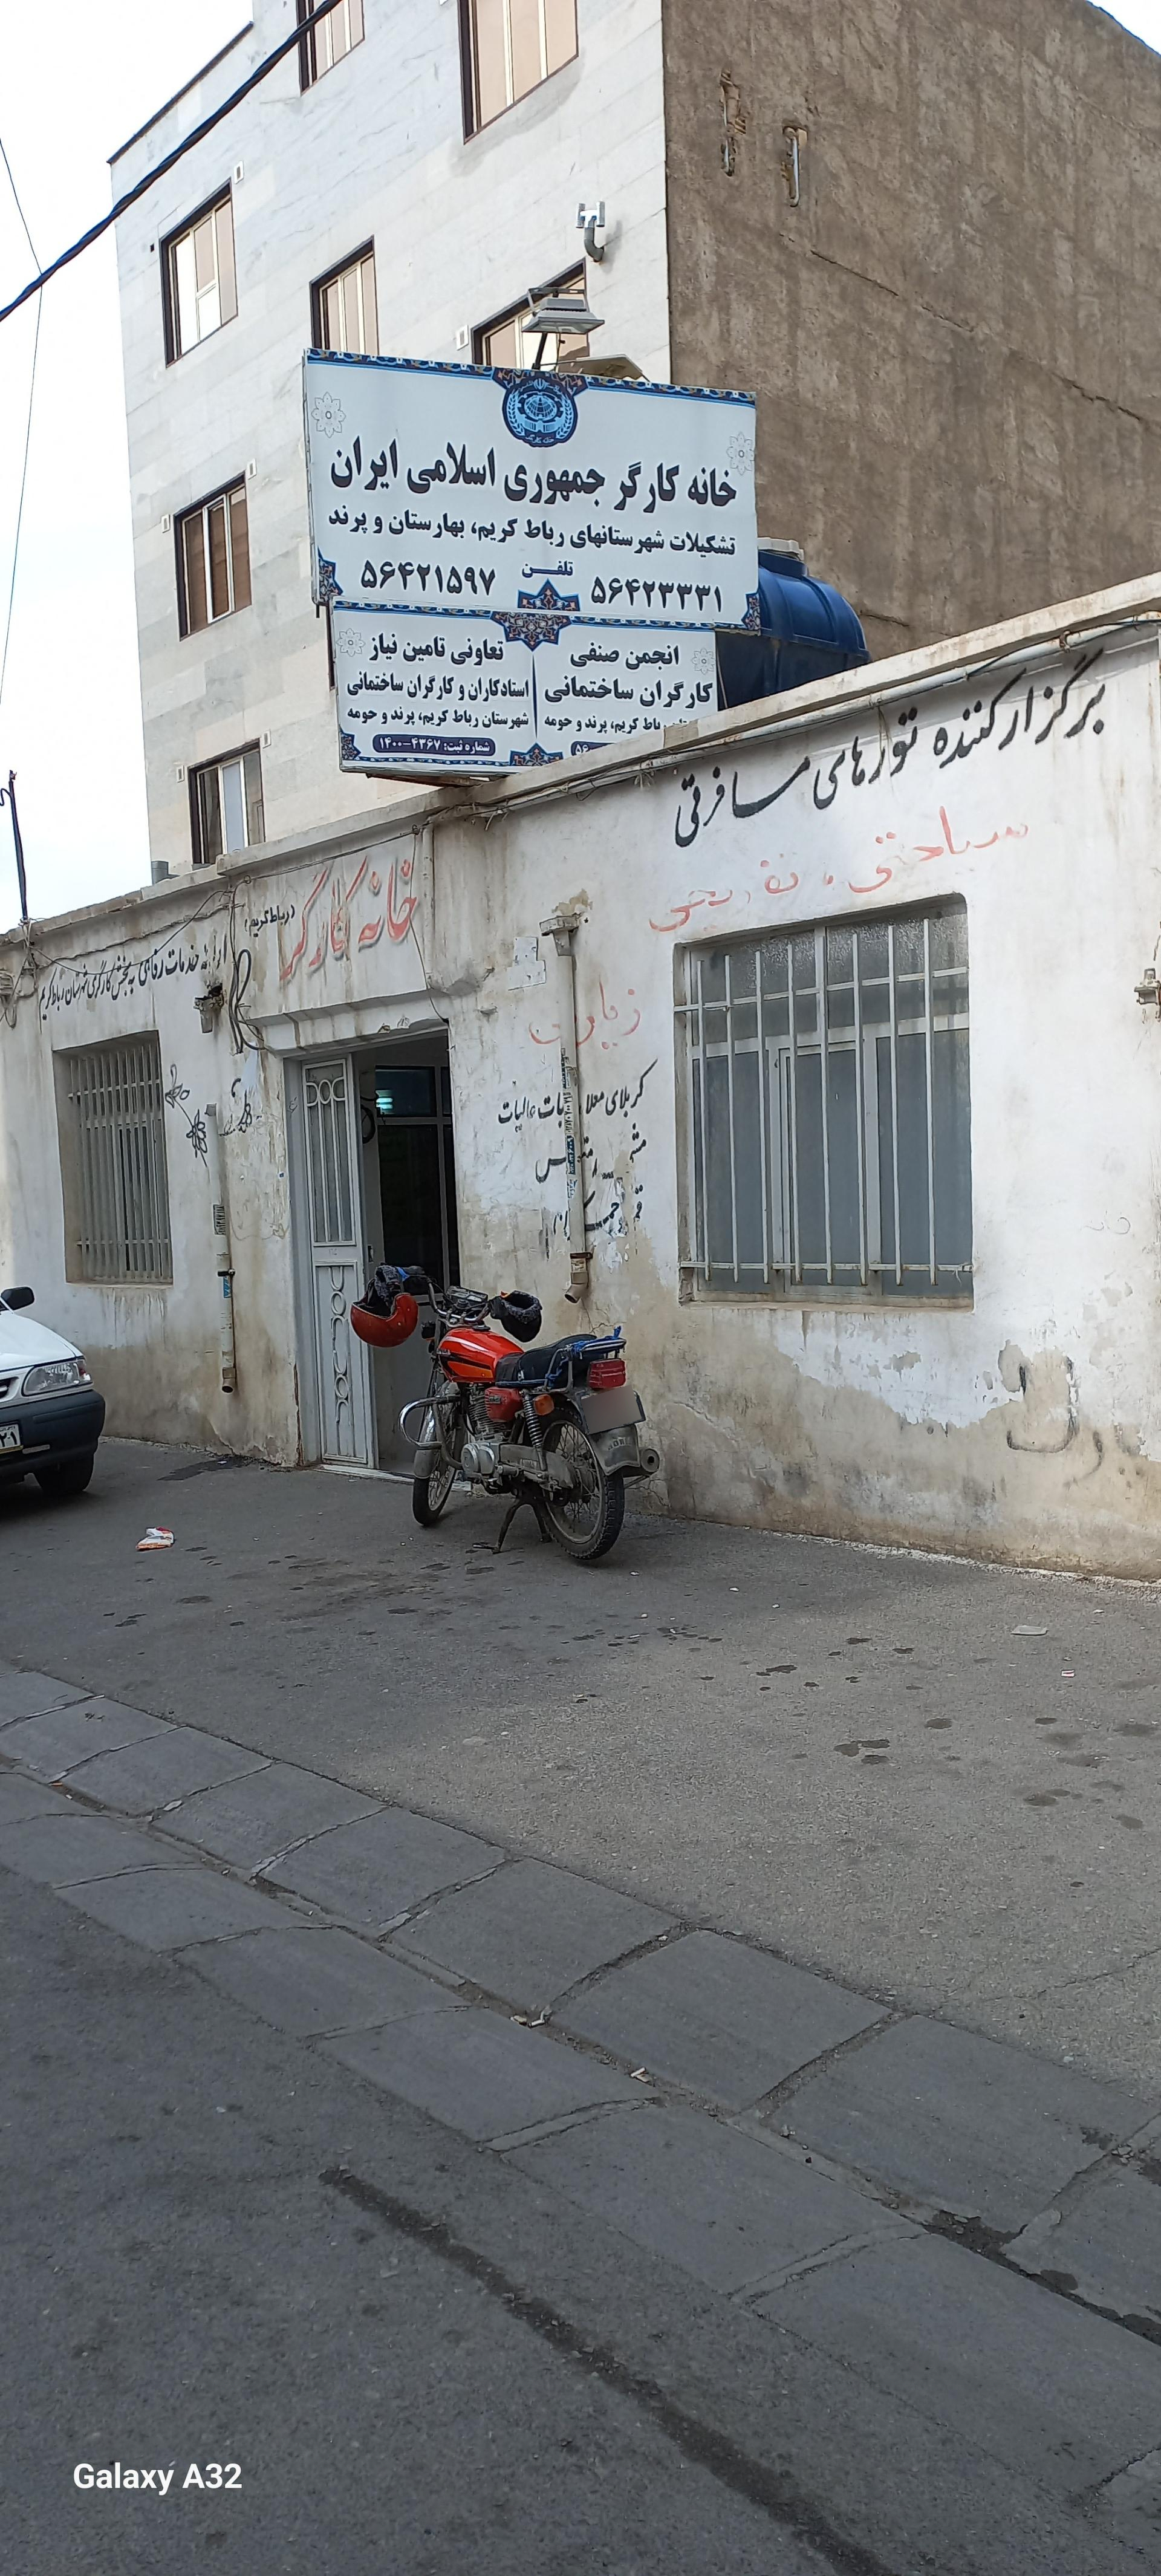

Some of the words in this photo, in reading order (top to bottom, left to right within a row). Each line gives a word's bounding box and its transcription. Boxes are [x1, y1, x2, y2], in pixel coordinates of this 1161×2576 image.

[330, 436, 398, 490] ایران
[406, 441, 496, 495] اسلامی
[504, 461, 605, 506] جمهوری
[614, 460, 679, 513] کارگر
[687, 469, 738, 507] خانه
[328, 505, 368, 533] پرند
[373, 516, 383, 532] و
[388, 509, 464, 539] بهارستان
[471, 518, 518, 541] کریم،
[524, 518, 565, 547] رباط
[569, 523, 665, 553] شهرستانهای
[669, 530, 737, 559] تشکیلات
[362, 559, 496, 596] ۵۶۴۲۱۵۹۷
[591, 576, 723, 613] ۵۶۴۲۳۳۳۱
[369, 633, 398, 661] نیاز
[402, 636, 446, 663] تامین
[450, 639, 504, 665] تعاونی
[570, 642, 620, 666] صنفی
[625, 645, 679, 672] انجمن
[346, 671, 403, 696] ساختمانی
[407, 674, 455, 700] کارگران
[458, 684, 466, 700] و
[468, 677, 529, 701] استادکاران
[544, 675, 633, 703] ساختمانی
[640, 680, 713, 709] کارگران
[347, 707, 377, 723] حومه
[382, 713, 387, 724] و
[391, 706, 414, 724] پرند
[418, 709, 448, 726] کریم،
[453, 709, 478, 727] رباط
[482, 711, 529, 729] شهرستان
[545, 715, 572, 730] حومه
[576, 720, 581, 731] و
[585, 716, 607, 733] پرند
[464, 741, 490, 752] شماره
[814, 707, 918, 810] تورهای
[674, 755, 811, 848] مسافرتی
[358, 858, 418, 943] خانه
[280, 856, 368, 981] کارگر
[605, 1058, 659, 1118] کربلای
